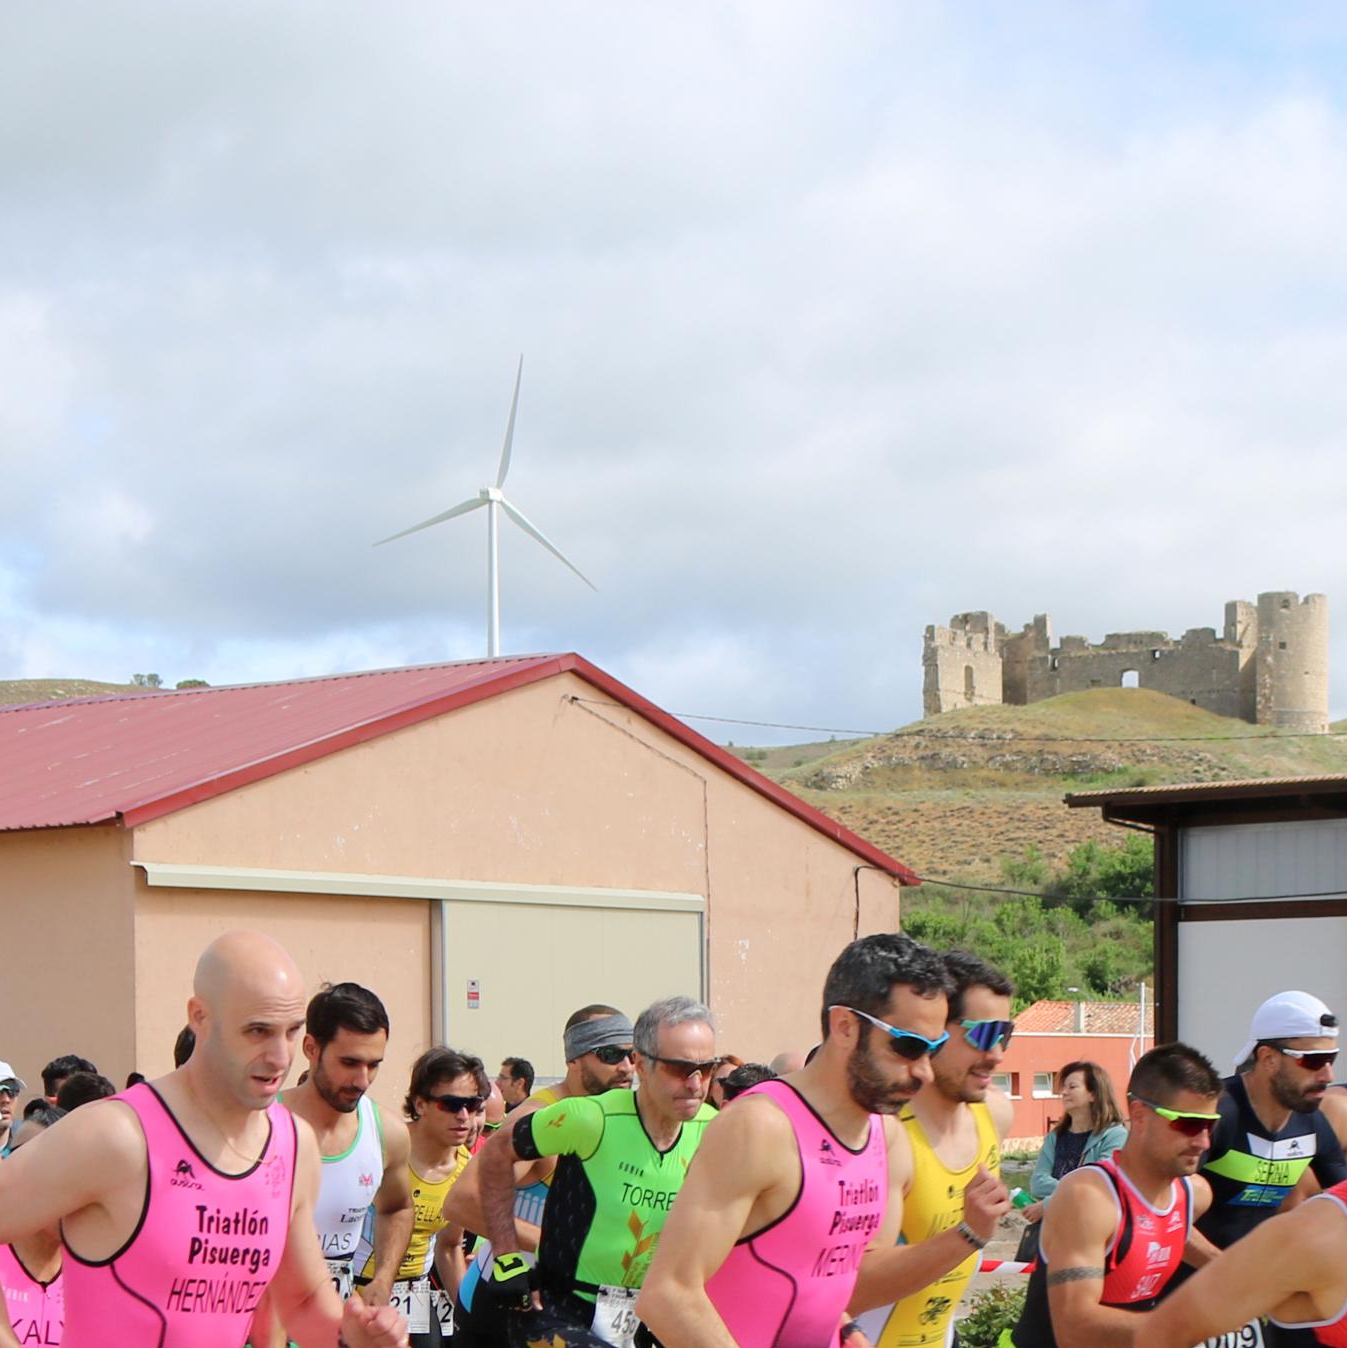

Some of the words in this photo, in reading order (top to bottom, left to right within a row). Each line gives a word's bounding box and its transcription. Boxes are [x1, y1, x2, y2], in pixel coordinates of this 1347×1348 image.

[196, 1205, 270, 1236] Triatlón
[829, 1211, 881, 1237] Pisuerga
[188, 1237, 271, 1275] Pisuerga
